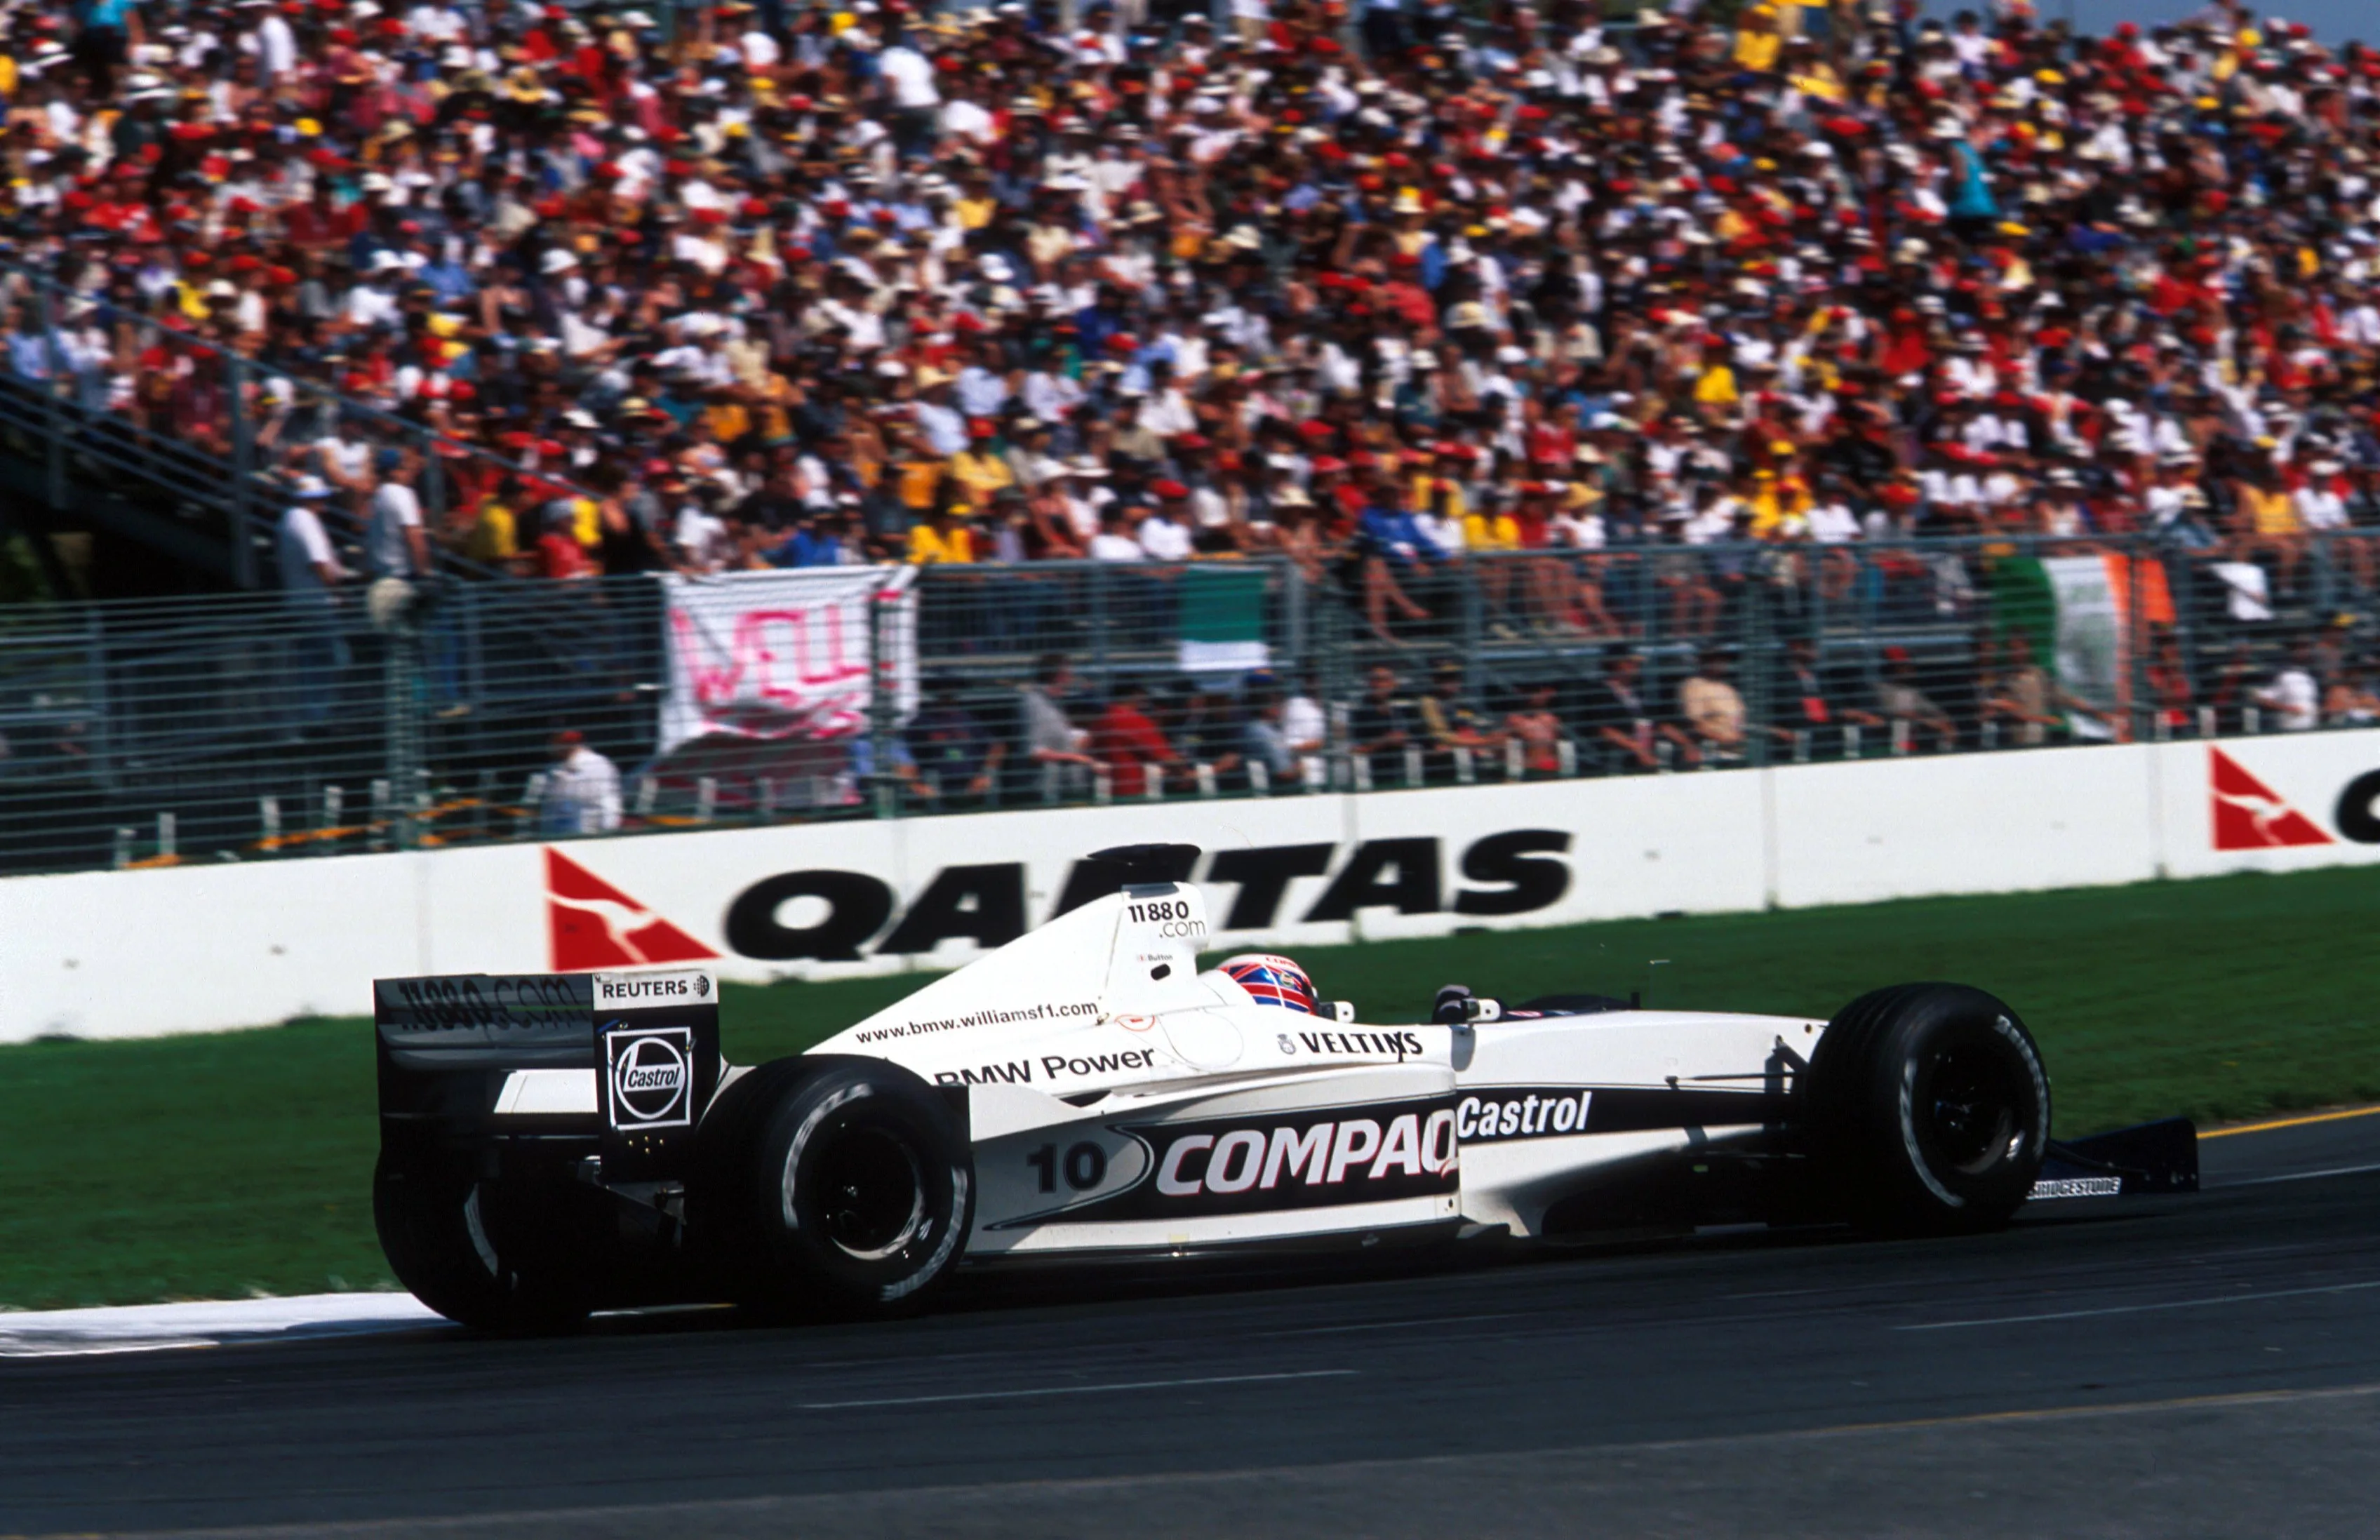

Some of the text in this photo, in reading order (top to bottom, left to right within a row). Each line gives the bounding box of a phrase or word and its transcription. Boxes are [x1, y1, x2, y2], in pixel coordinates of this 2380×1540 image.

[1128, 900, 1189, 923] 11880
[1159, 920, 1206, 938] .com
[603, 980, 688, 998] REUTERS
[856, 1000, 1099, 1044] www.bmw.williamsf1.com
[1298, 1031, 1423, 1055] VELTINS
[628, 1066, 680, 1087] Castrol
[1041, 1048, 1155, 1078] Power
[1457, 1092, 1591, 1139] Castrol
[1156, 1108, 1458, 1196] COMPAQ
[1027, 1141, 1107, 1194] 10
